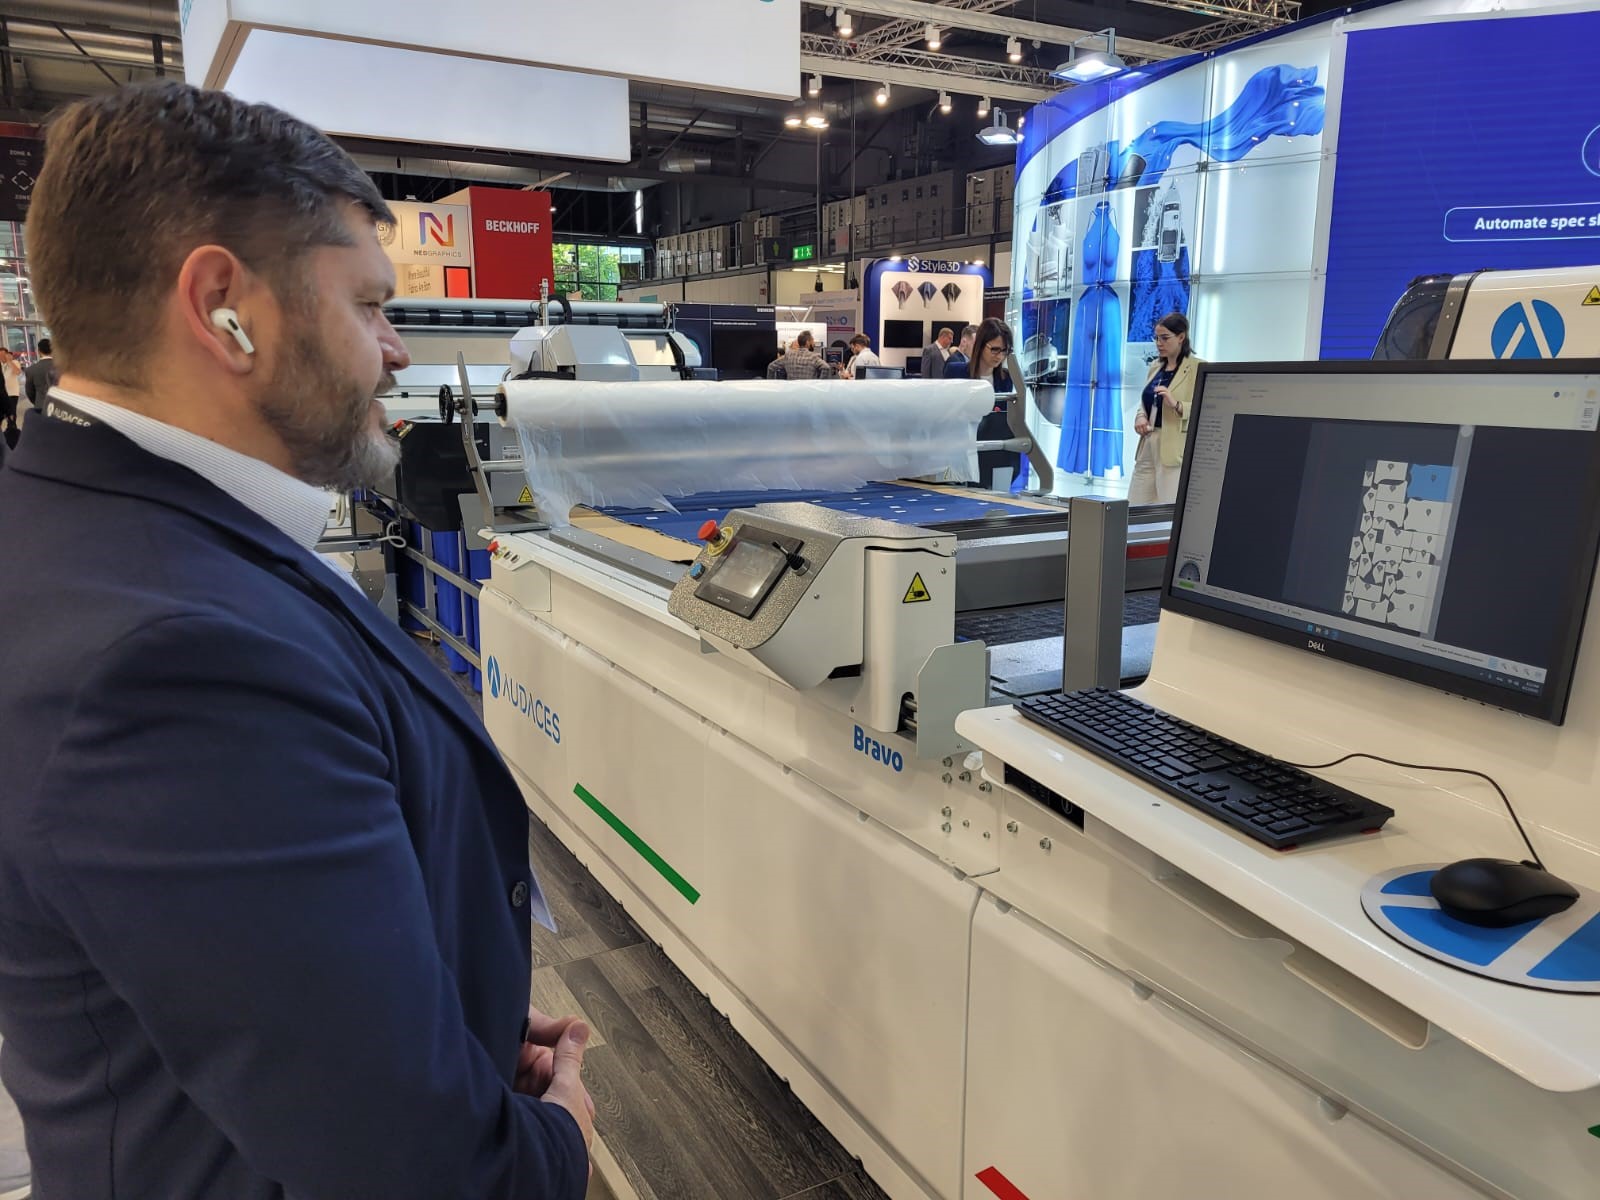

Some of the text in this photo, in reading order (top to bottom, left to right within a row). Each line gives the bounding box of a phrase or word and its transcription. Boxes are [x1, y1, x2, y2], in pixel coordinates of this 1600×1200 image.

[485, 219, 540, 234] BECKHOFF
[1474, 216, 1548, 230] Automate
[1550, 216, 1586, 230] spec
[413, 249, 462, 258] NEOGRAPHICS
[921, 260, 961, 273] Style3D
[1307, 640, 1326, 653] DELL
[503, 672, 561, 744] AUDACES
[854, 724, 903, 773] Bravo
